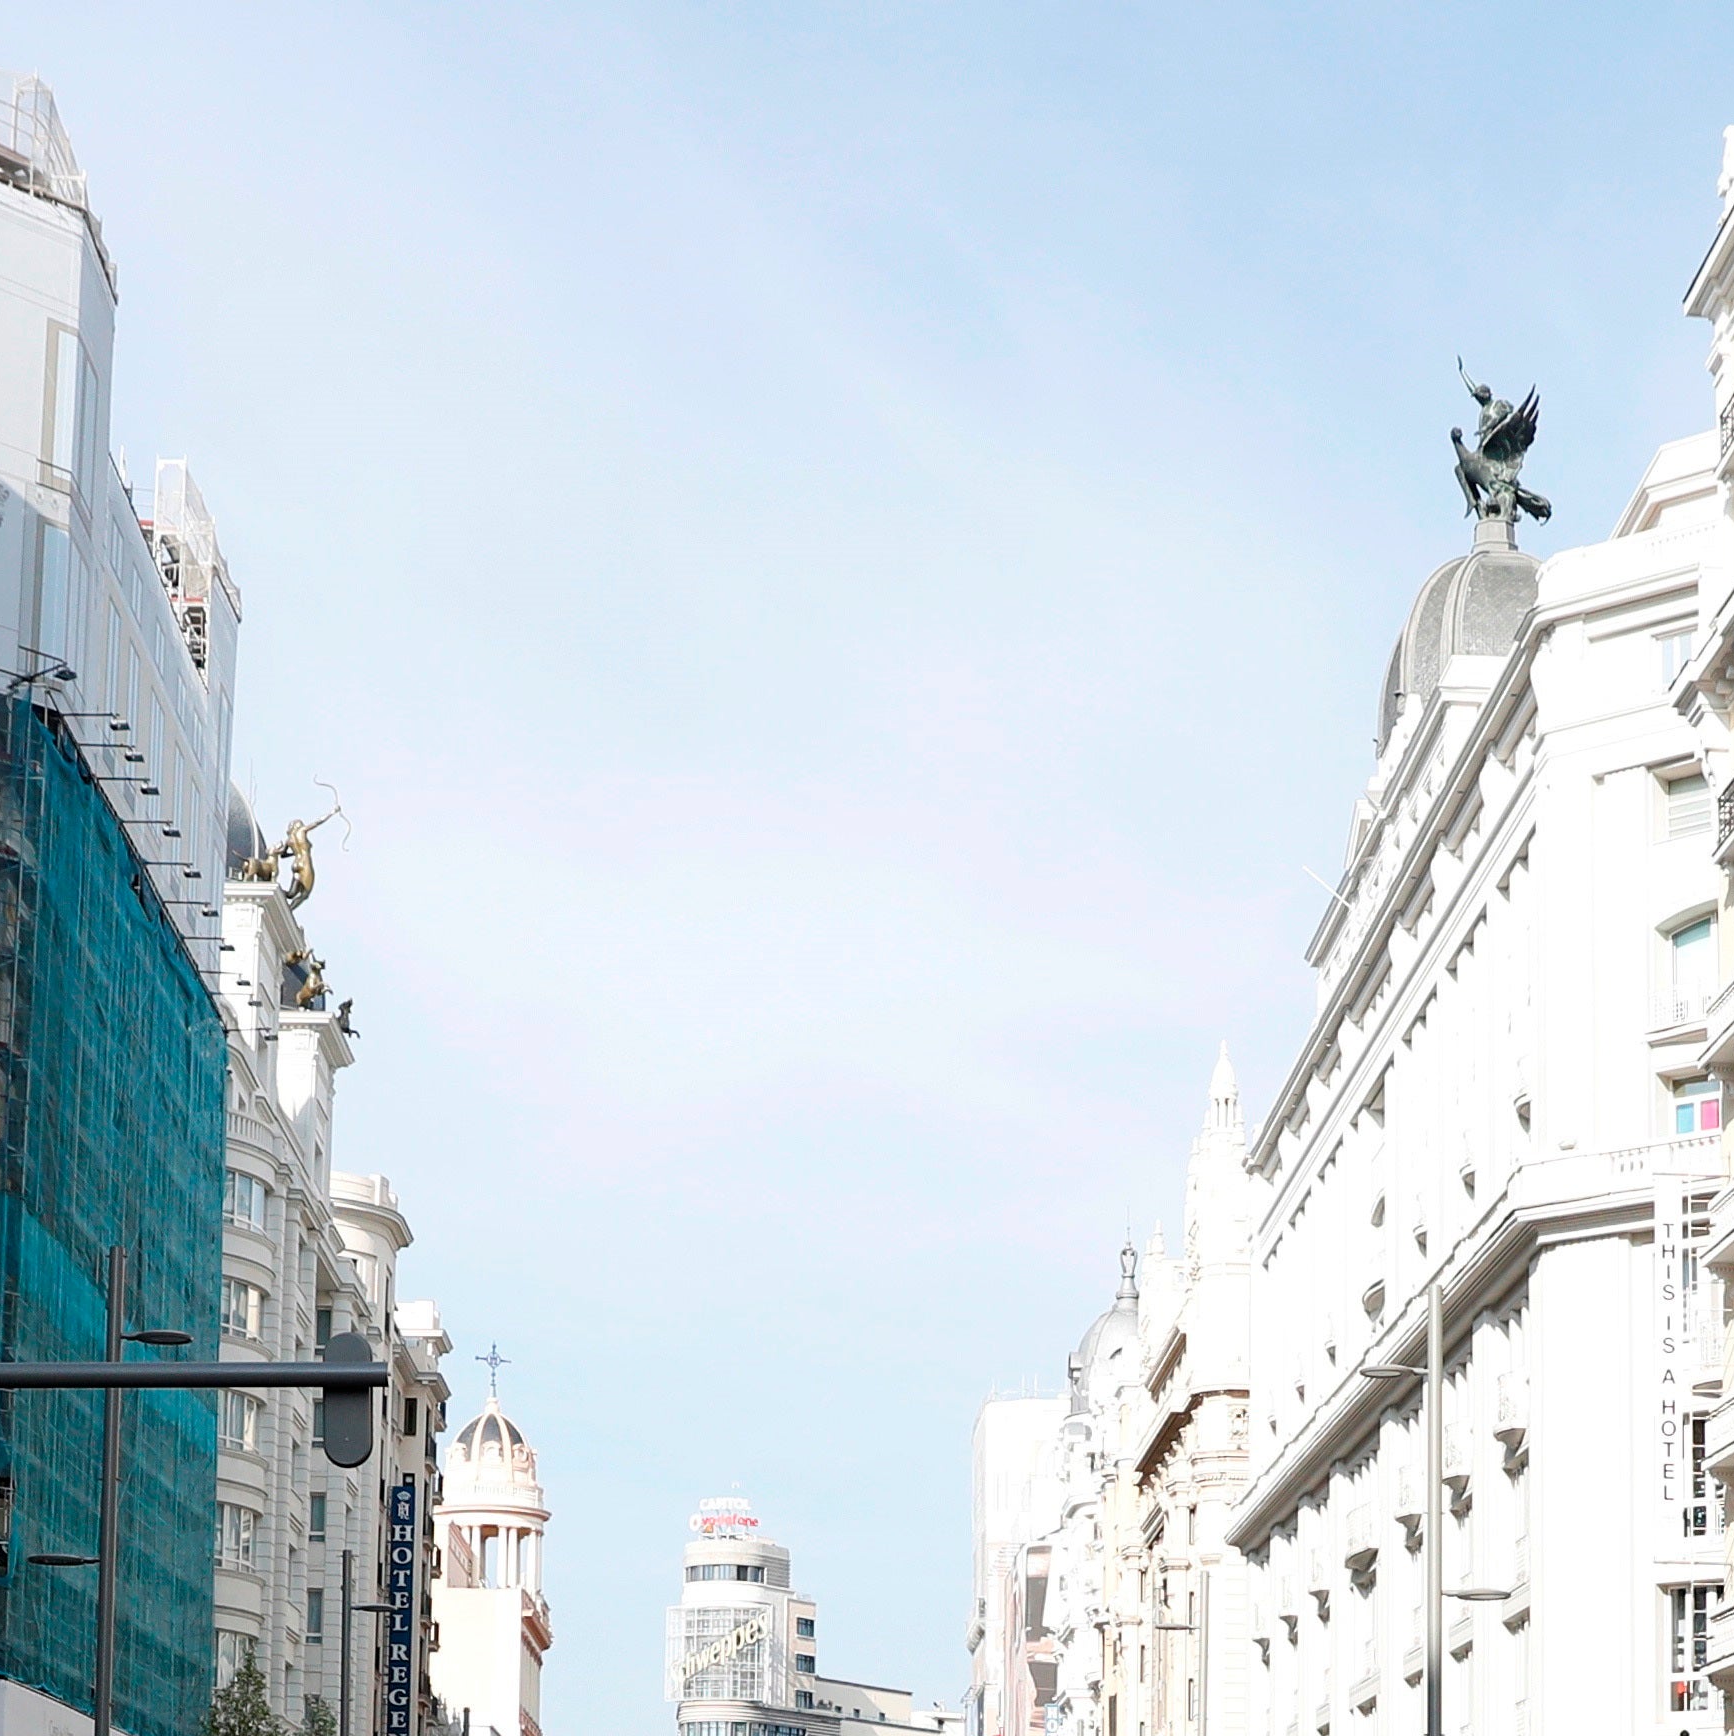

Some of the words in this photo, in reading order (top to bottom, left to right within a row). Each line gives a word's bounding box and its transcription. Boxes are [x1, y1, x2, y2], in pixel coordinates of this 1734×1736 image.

[1662, 1223, 1676, 1301] THIS
[1662, 1315, 1676, 1354] IS
[1662, 1369, 1676, 1385] A
[1660, 1400, 1677, 1501] HOTEL
[701, 1514, 760, 1528] vodafone
[391, 1524, 413, 1632] HOTEL
[670, 1611, 770, 1688] Schweppes
